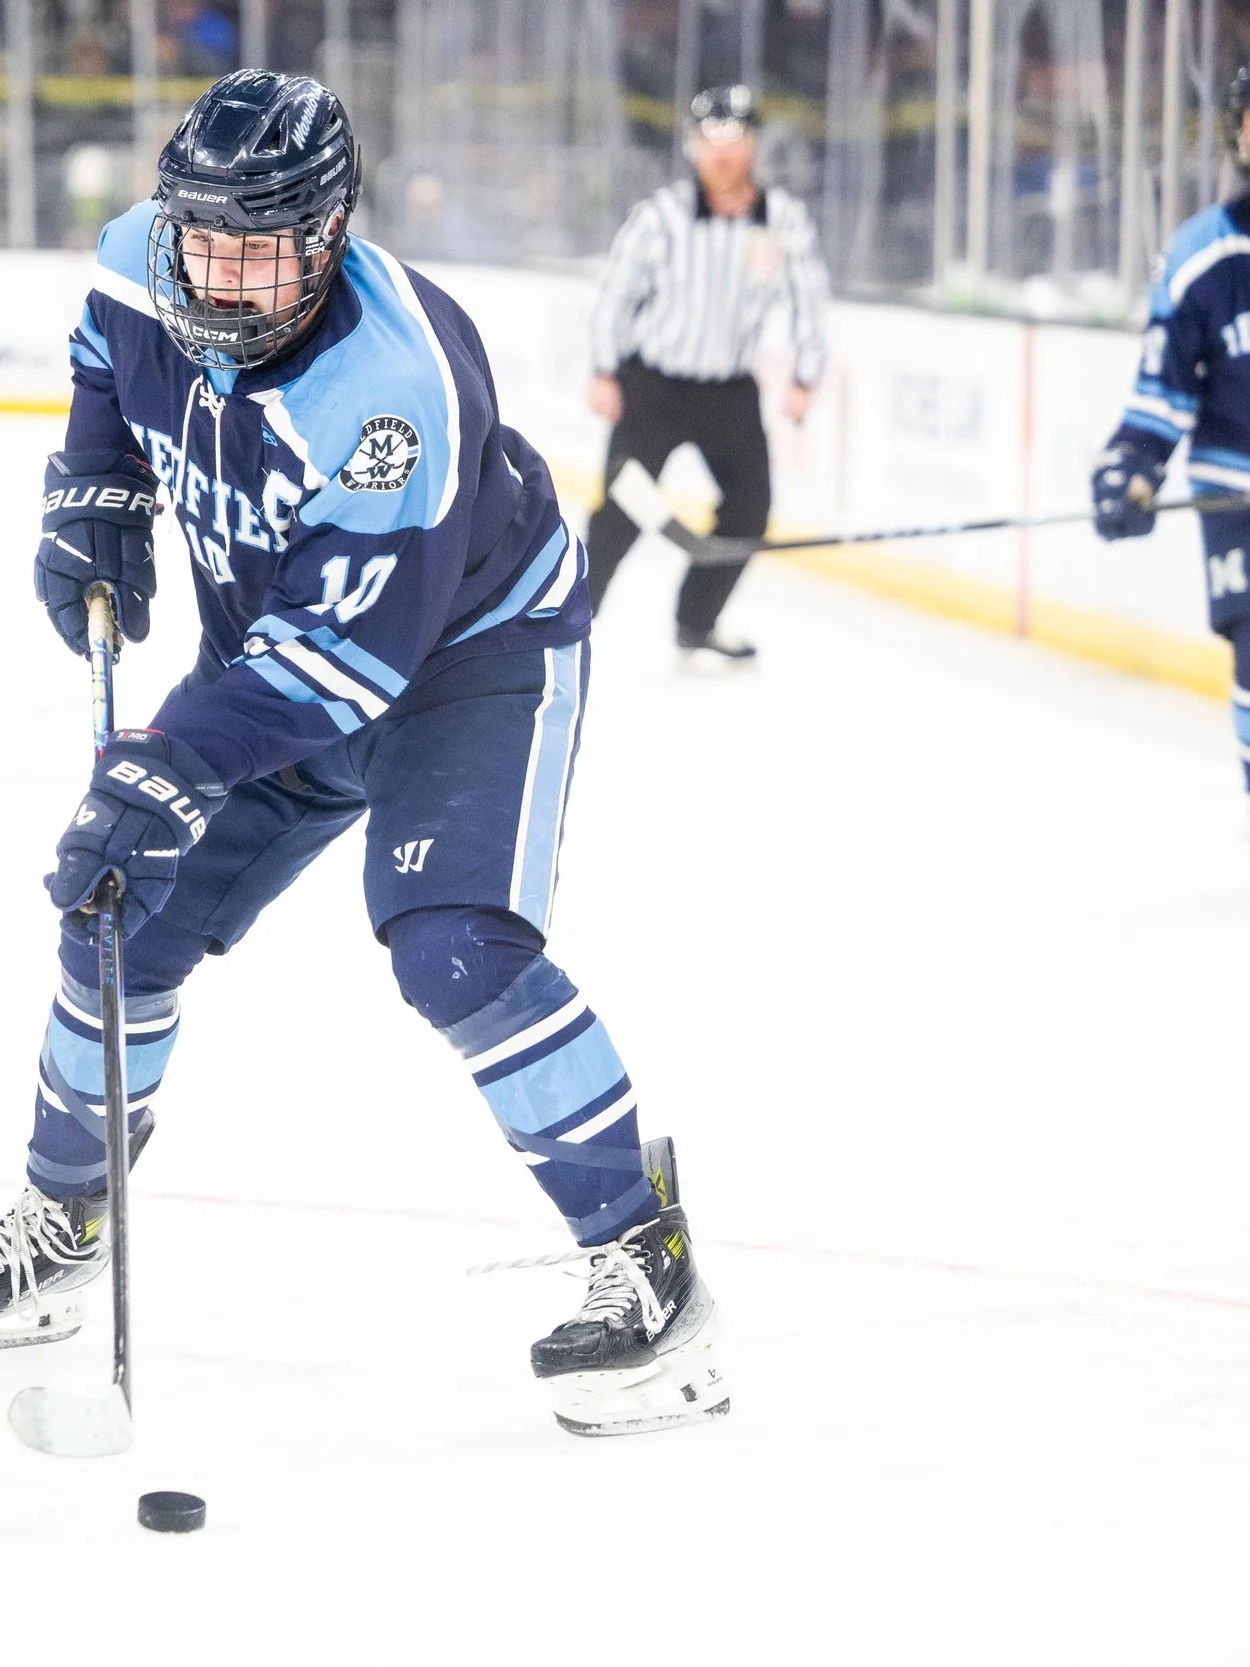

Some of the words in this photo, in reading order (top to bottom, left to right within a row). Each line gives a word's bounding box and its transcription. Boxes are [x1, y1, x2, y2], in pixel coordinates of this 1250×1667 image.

[177, 189, 228, 205] BAUER
[305, 245, 325, 257] CCM
[192, 325, 239, 342] CCM
[360, 418, 413, 442] DFIELD
[185, 521, 236, 585] 10
[303, 553, 399, 624] 10
[106, 760, 207, 845] BAUE
[645, 1299, 678, 1343] BER
